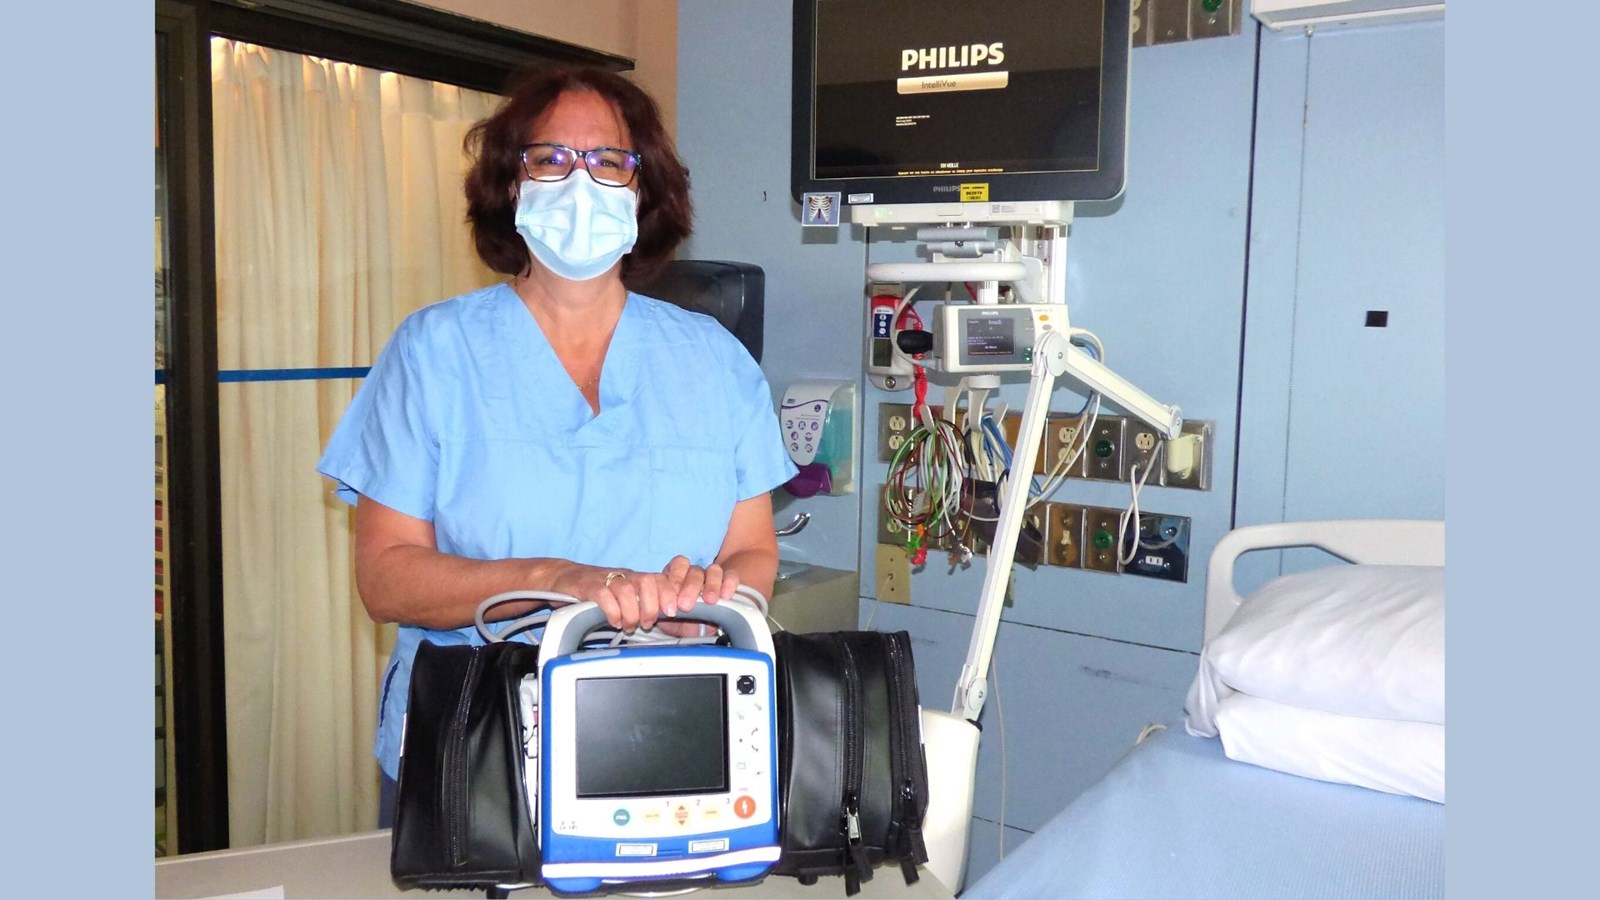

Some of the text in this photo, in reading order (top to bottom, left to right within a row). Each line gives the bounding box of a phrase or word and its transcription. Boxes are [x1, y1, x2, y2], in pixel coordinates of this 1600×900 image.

[901, 42, 1005, 71] PHILIPS
[921, 79, 957, 89] IntelliVue
[932, 185, 961, 193] PHILIPS
